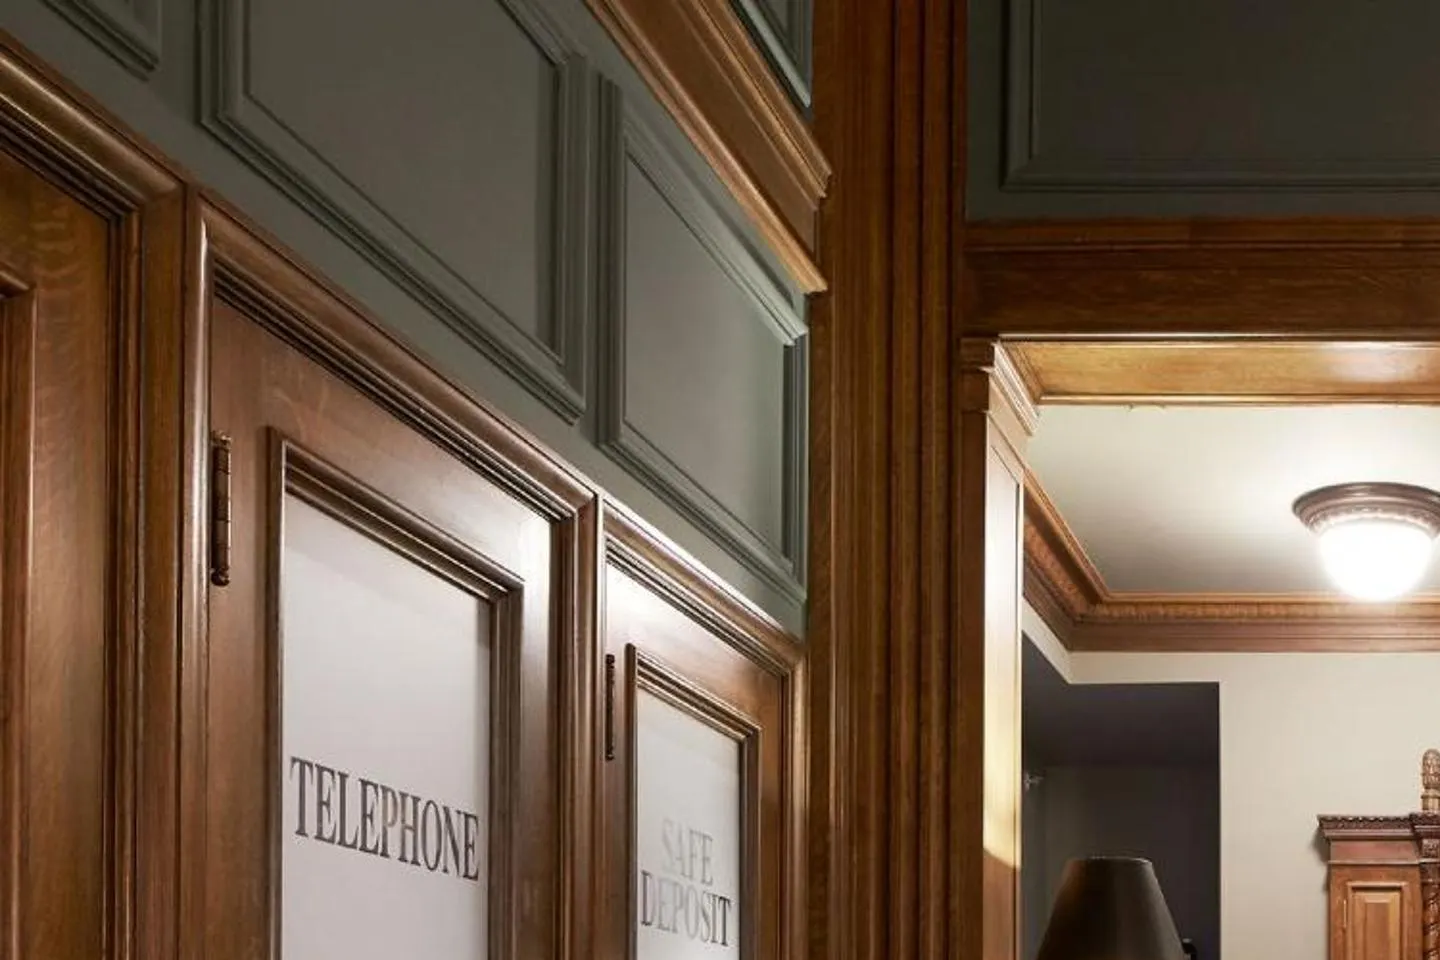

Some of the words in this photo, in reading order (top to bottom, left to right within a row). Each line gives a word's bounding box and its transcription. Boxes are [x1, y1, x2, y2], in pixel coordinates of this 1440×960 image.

[289, 756, 481, 881] TELEPHONE
[661, 818, 713, 886] SAFE
[641, 869, 732, 946] DEPOSIT
